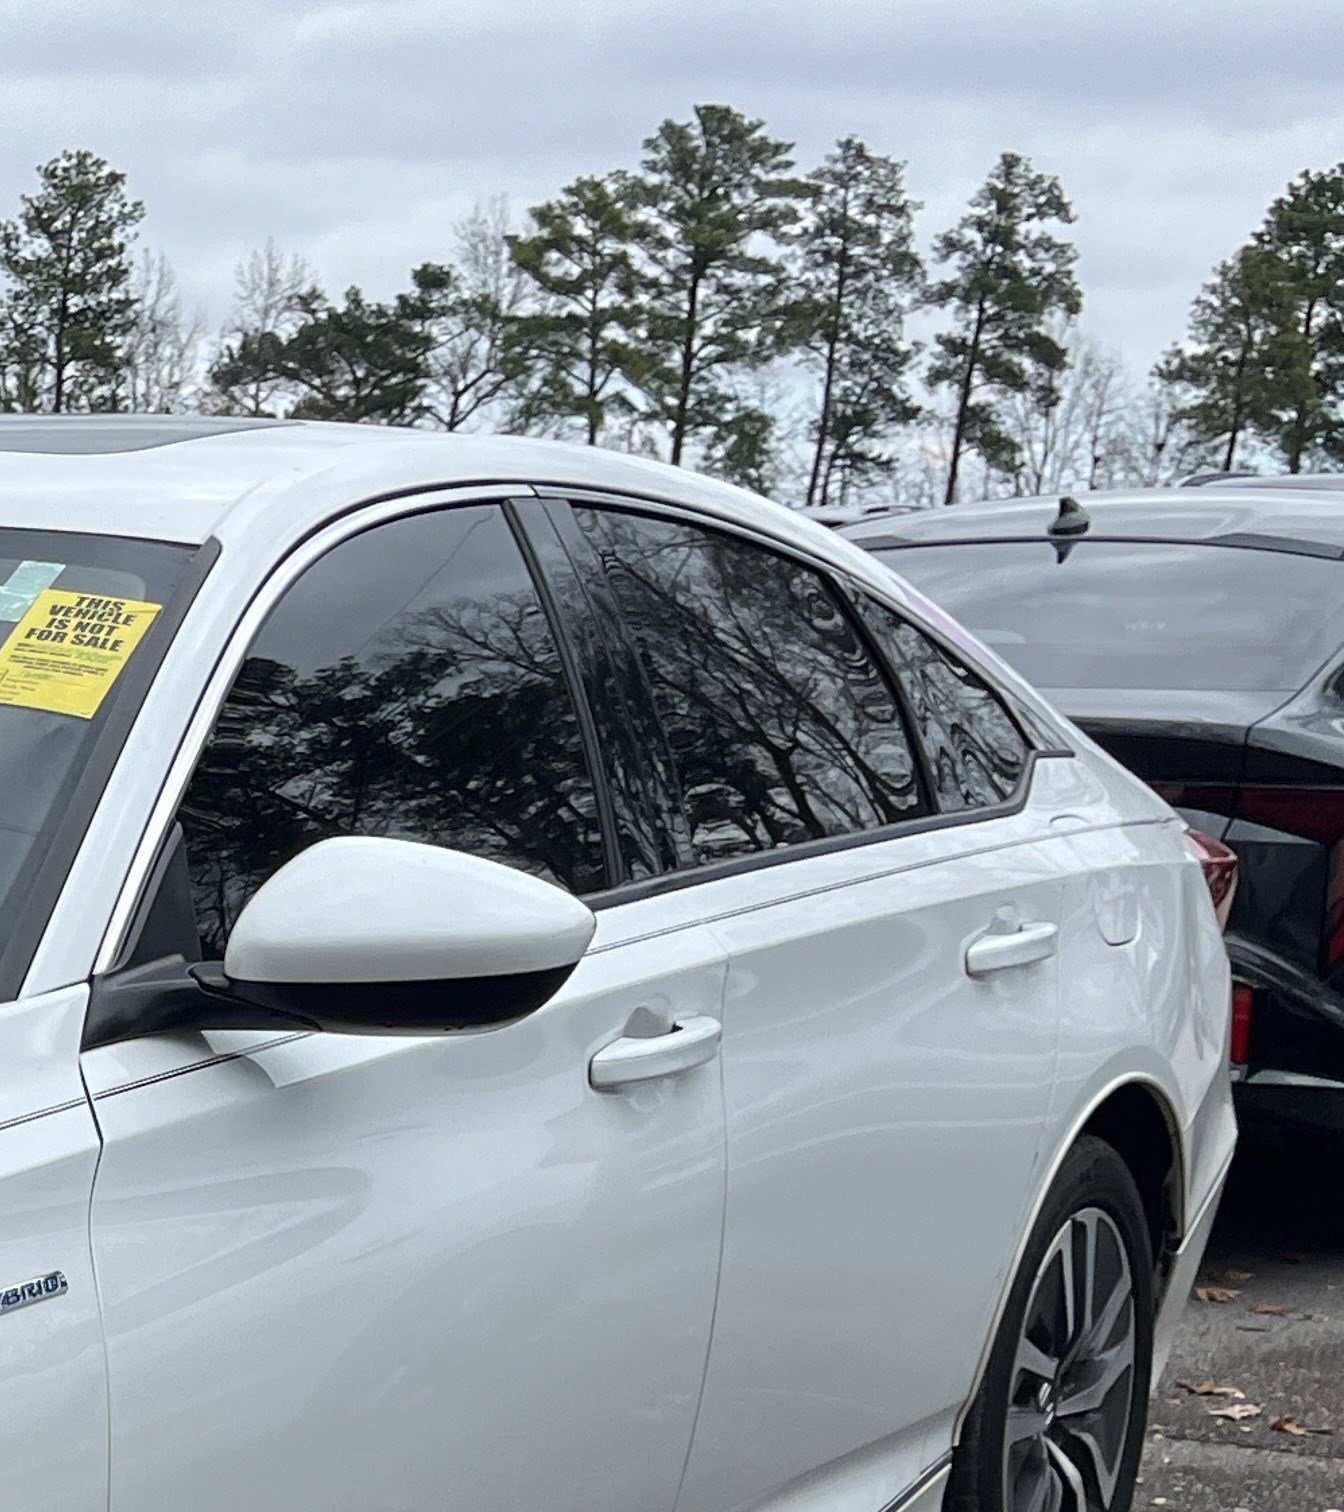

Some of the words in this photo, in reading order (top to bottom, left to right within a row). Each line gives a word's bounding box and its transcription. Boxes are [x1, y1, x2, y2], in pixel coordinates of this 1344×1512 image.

[74, 595, 127, 612] THIS
[48, 604, 137, 626] VEHICLE
[44, 617, 72, 630] IS
[72, 620, 121, 637] NOT
[24, 627, 69, 643] FOR
[70, 634, 126, 652] SALE
